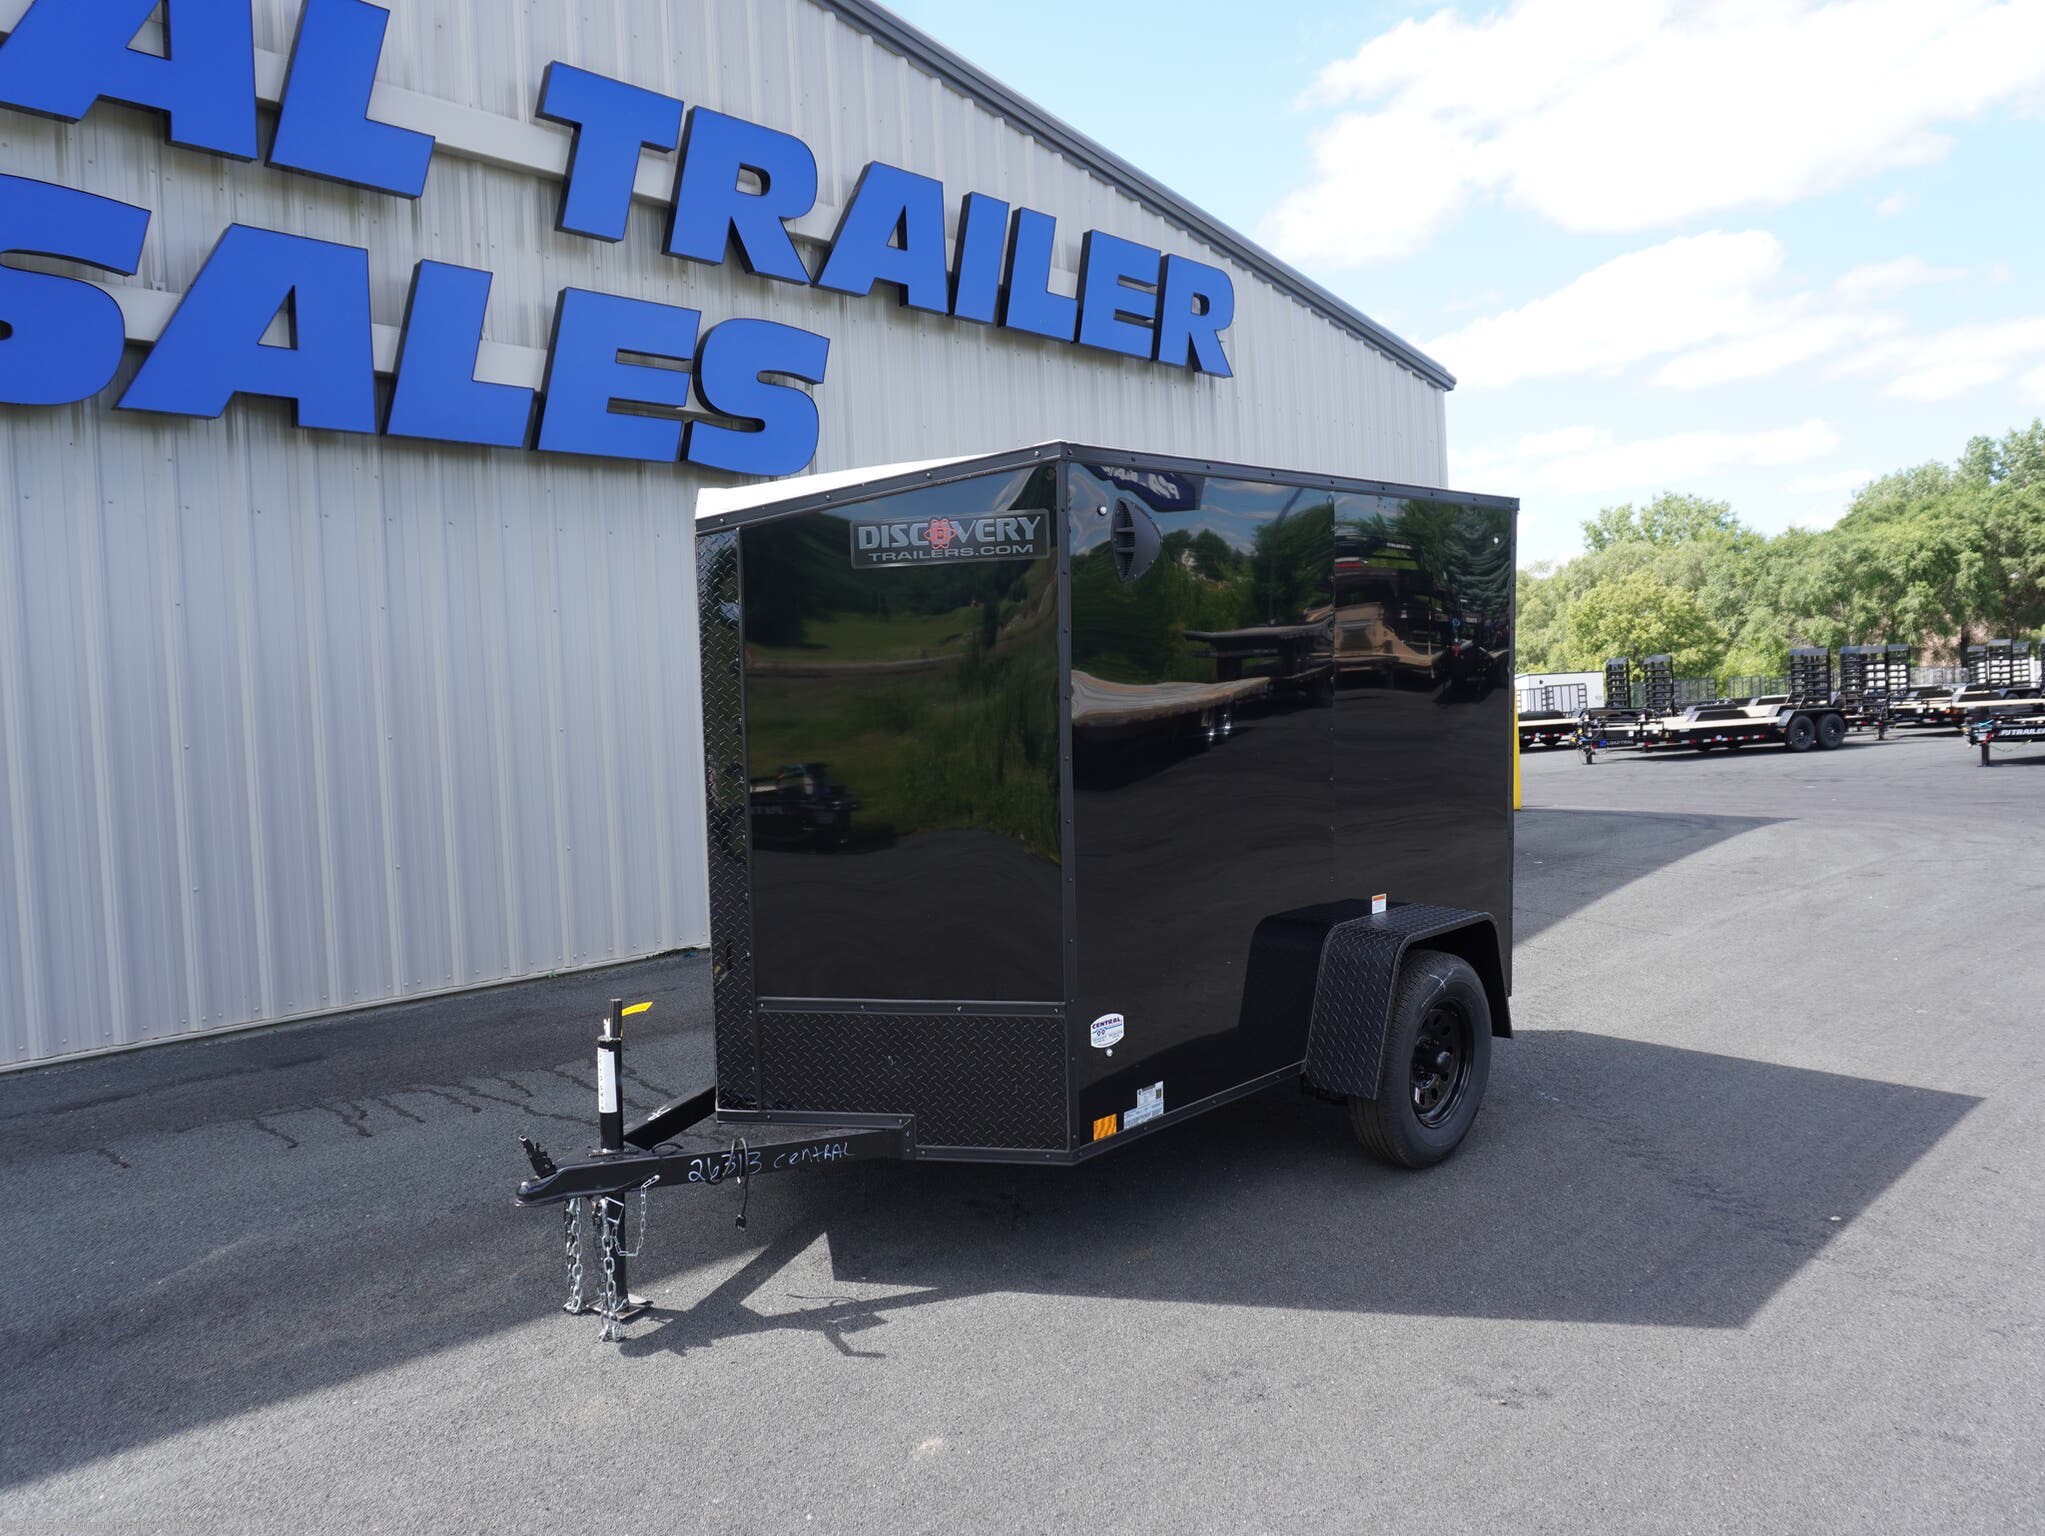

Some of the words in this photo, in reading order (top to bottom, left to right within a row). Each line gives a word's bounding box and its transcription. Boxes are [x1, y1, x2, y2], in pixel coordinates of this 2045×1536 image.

[535, 60, 1235, 378] TRAILER
[0, 173, 831, 477] SALES
[868, 544, 1034, 562] TRAILERS.COM
[1092, 1017, 1121, 1029] CENTRAL
